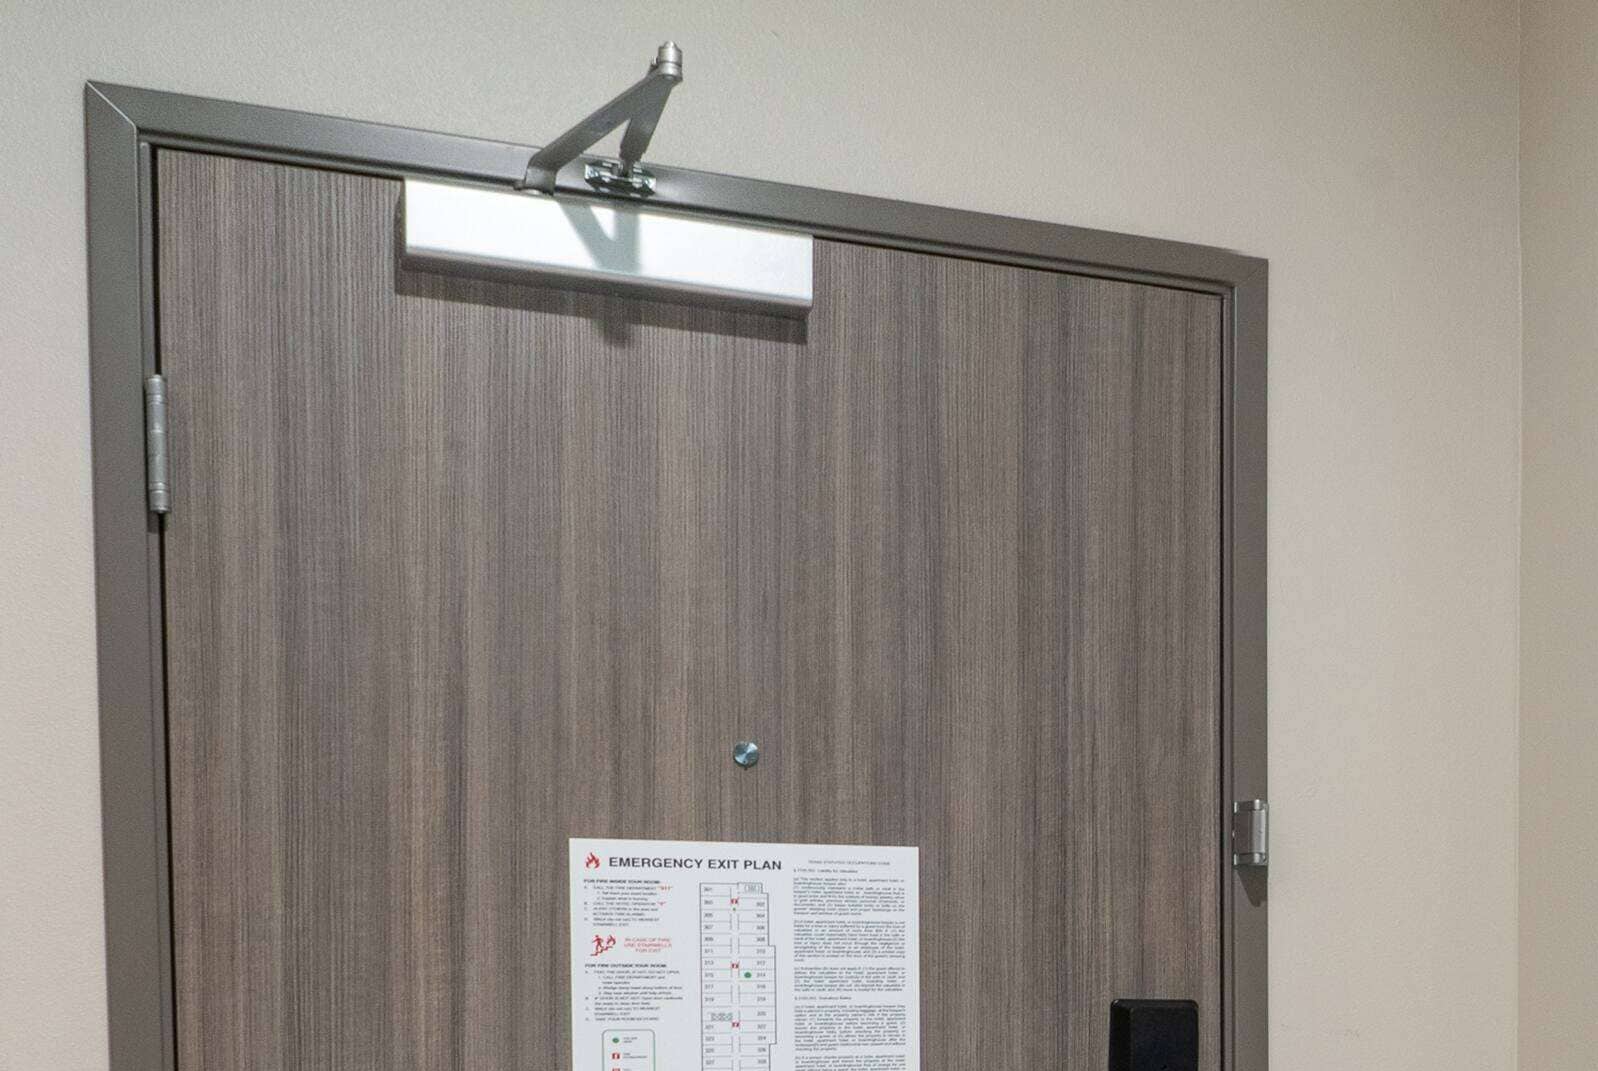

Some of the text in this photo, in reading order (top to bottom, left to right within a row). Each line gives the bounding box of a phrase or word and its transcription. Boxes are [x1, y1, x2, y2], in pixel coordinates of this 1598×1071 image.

[609, 856, 703, 870] EMERGENCY
[708, 859, 739, 870] EXIT
[744, 860, 782, 871] PLAN
